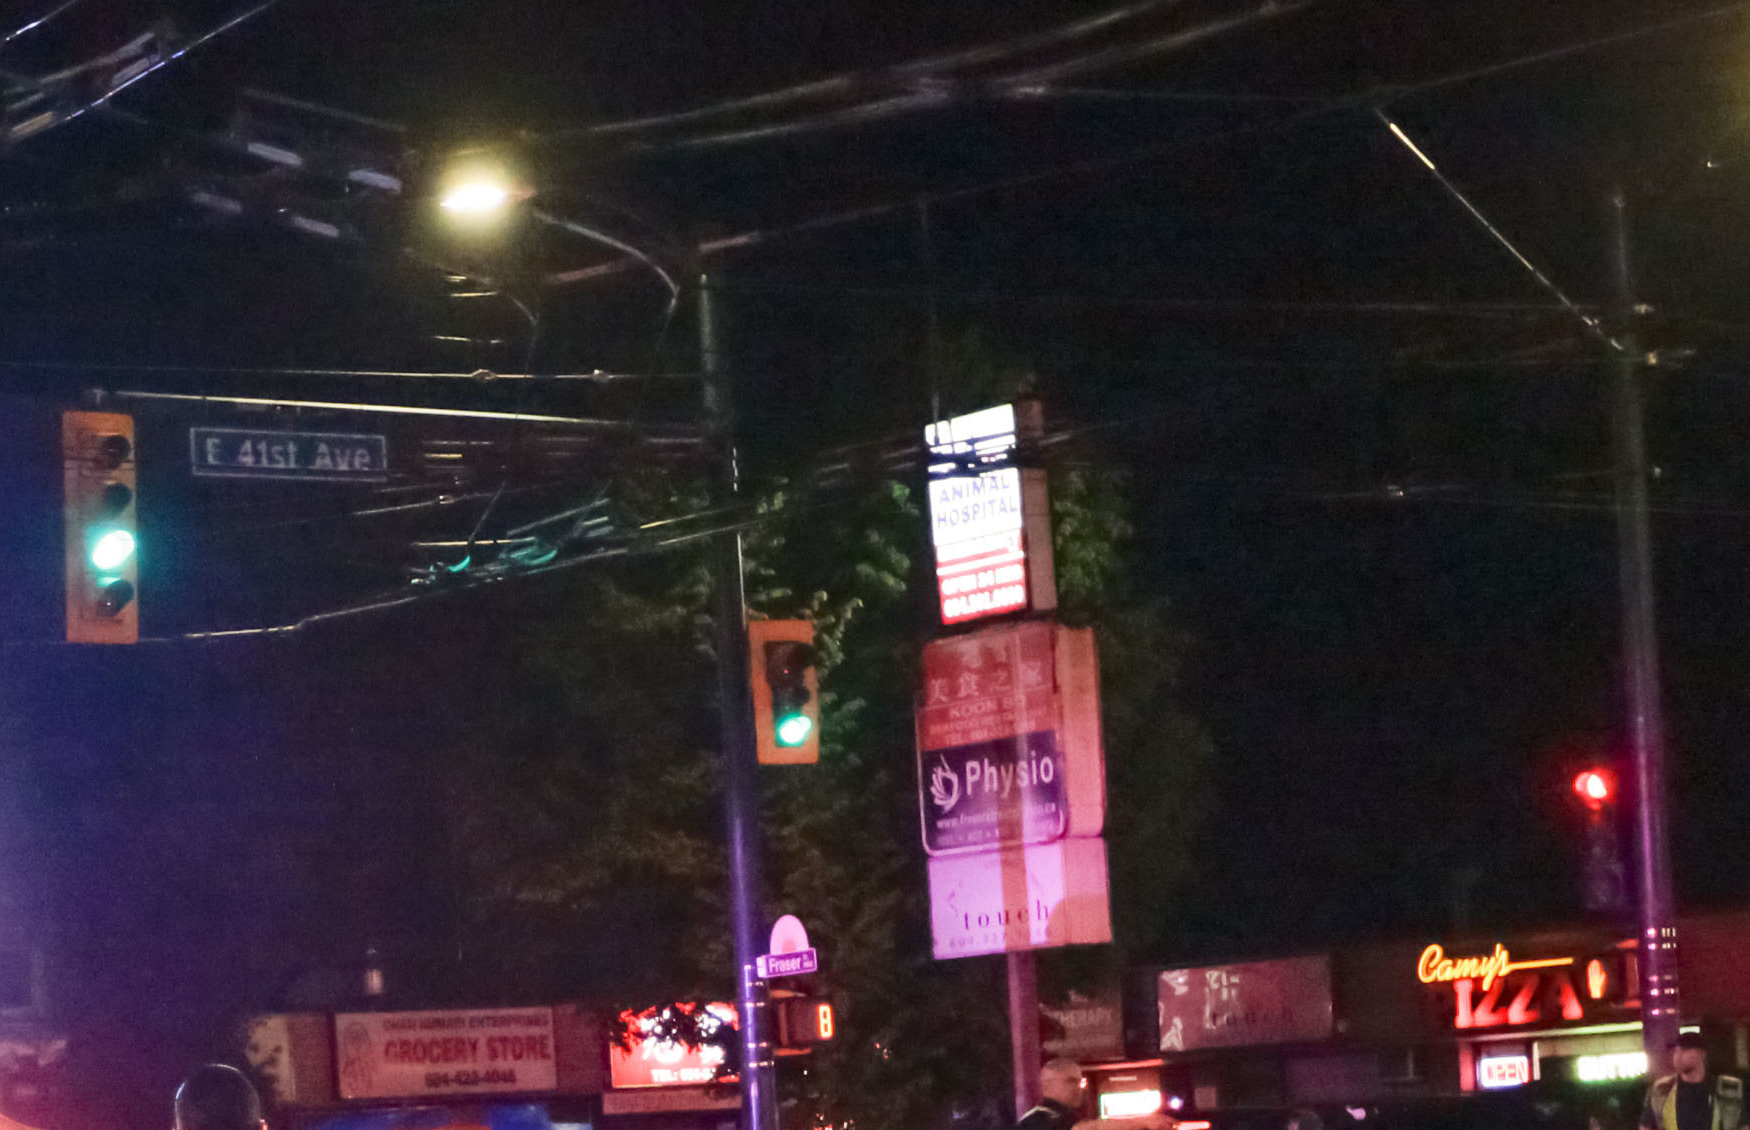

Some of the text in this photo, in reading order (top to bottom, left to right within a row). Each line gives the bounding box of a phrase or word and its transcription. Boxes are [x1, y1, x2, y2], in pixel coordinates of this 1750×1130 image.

[205, 437, 373, 472] E 41st Ave
[940, 474, 1011, 504] ANIMAL
[936, 495, 1018, 528] HOSPITAL
[965, 749, 1054, 798] Physio
[964, 899, 1049, 930] touch
[768, 957, 802, 974] Fraser
[1418, 943, 1573, 992] Camy's
[1453, 971, 1584, 1029] IZZA
[383, 1033, 551, 1064] GROCERY STORE
[1484, 1060, 1528, 1084] OPEN
